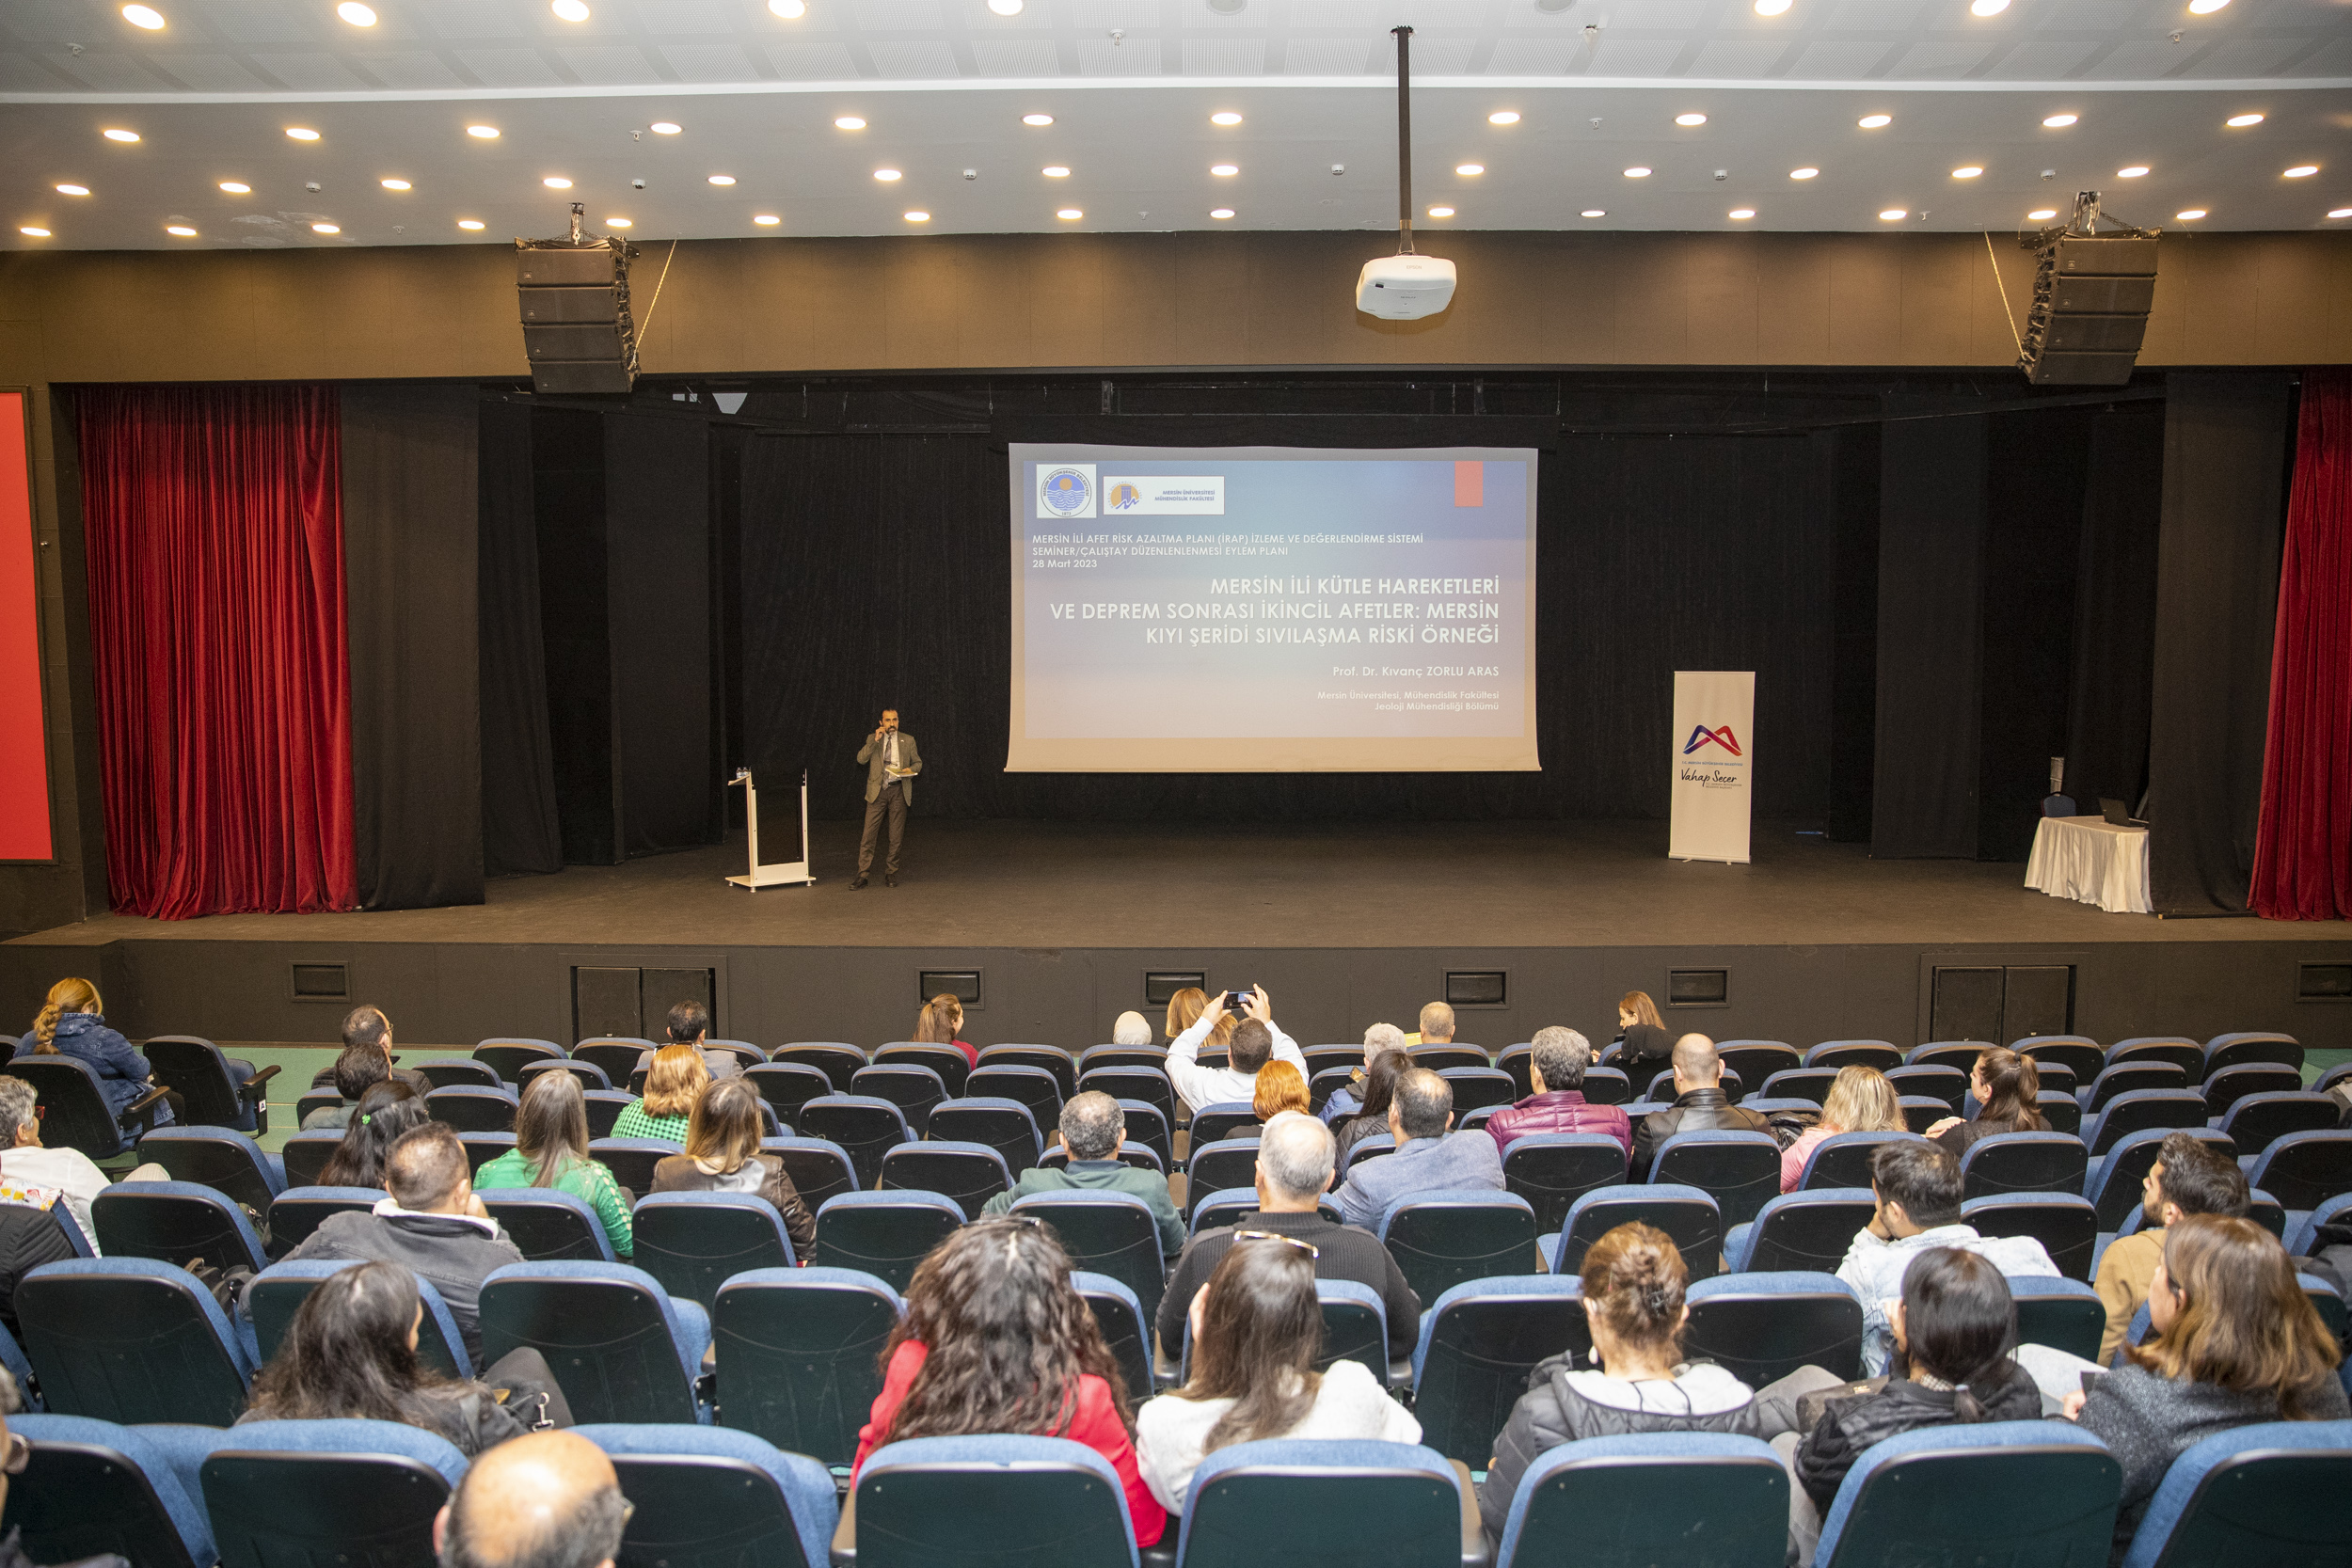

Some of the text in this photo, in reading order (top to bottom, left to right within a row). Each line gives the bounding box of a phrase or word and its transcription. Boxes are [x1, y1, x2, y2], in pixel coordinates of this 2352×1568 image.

[1032, 532, 1423, 546] MERSİN İLİ AFET RİSK AZALTMA PLANI (İRAP) İZLEME VE DEĞERLENDİRME SİSTEMİ
[1032, 545, 1289, 558] SEMİNER/ÇALIŞTAY DÜZENLENLENMESİ EYLEM PLANI
[1032, 559, 1098, 568] 28 Mart 2023
[1210, 575, 1500, 594] MERSİN İLİ KÜTLE HAREKETLERİ
[1050, 599, 1499, 620] VE DEPREM SONRASI İKİNCİL AFETLER: MERSİN
[1146, 624, 1499, 647] KIYI ŞERİDİ SIVILAŞMA RİSKİ ÖRNEĞİ
[1333, 666, 1500, 679] Prof. Dr. Kıvanç ZORLU ARAS
[1317, 689, 1500, 701] Mersin Üniversitesi, Mühendislik Fakültesi
[1375, 702, 1500, 712] Jeoloji Mühendisliği Bölümü
[1681, 768, 1710, 787] Vahap
